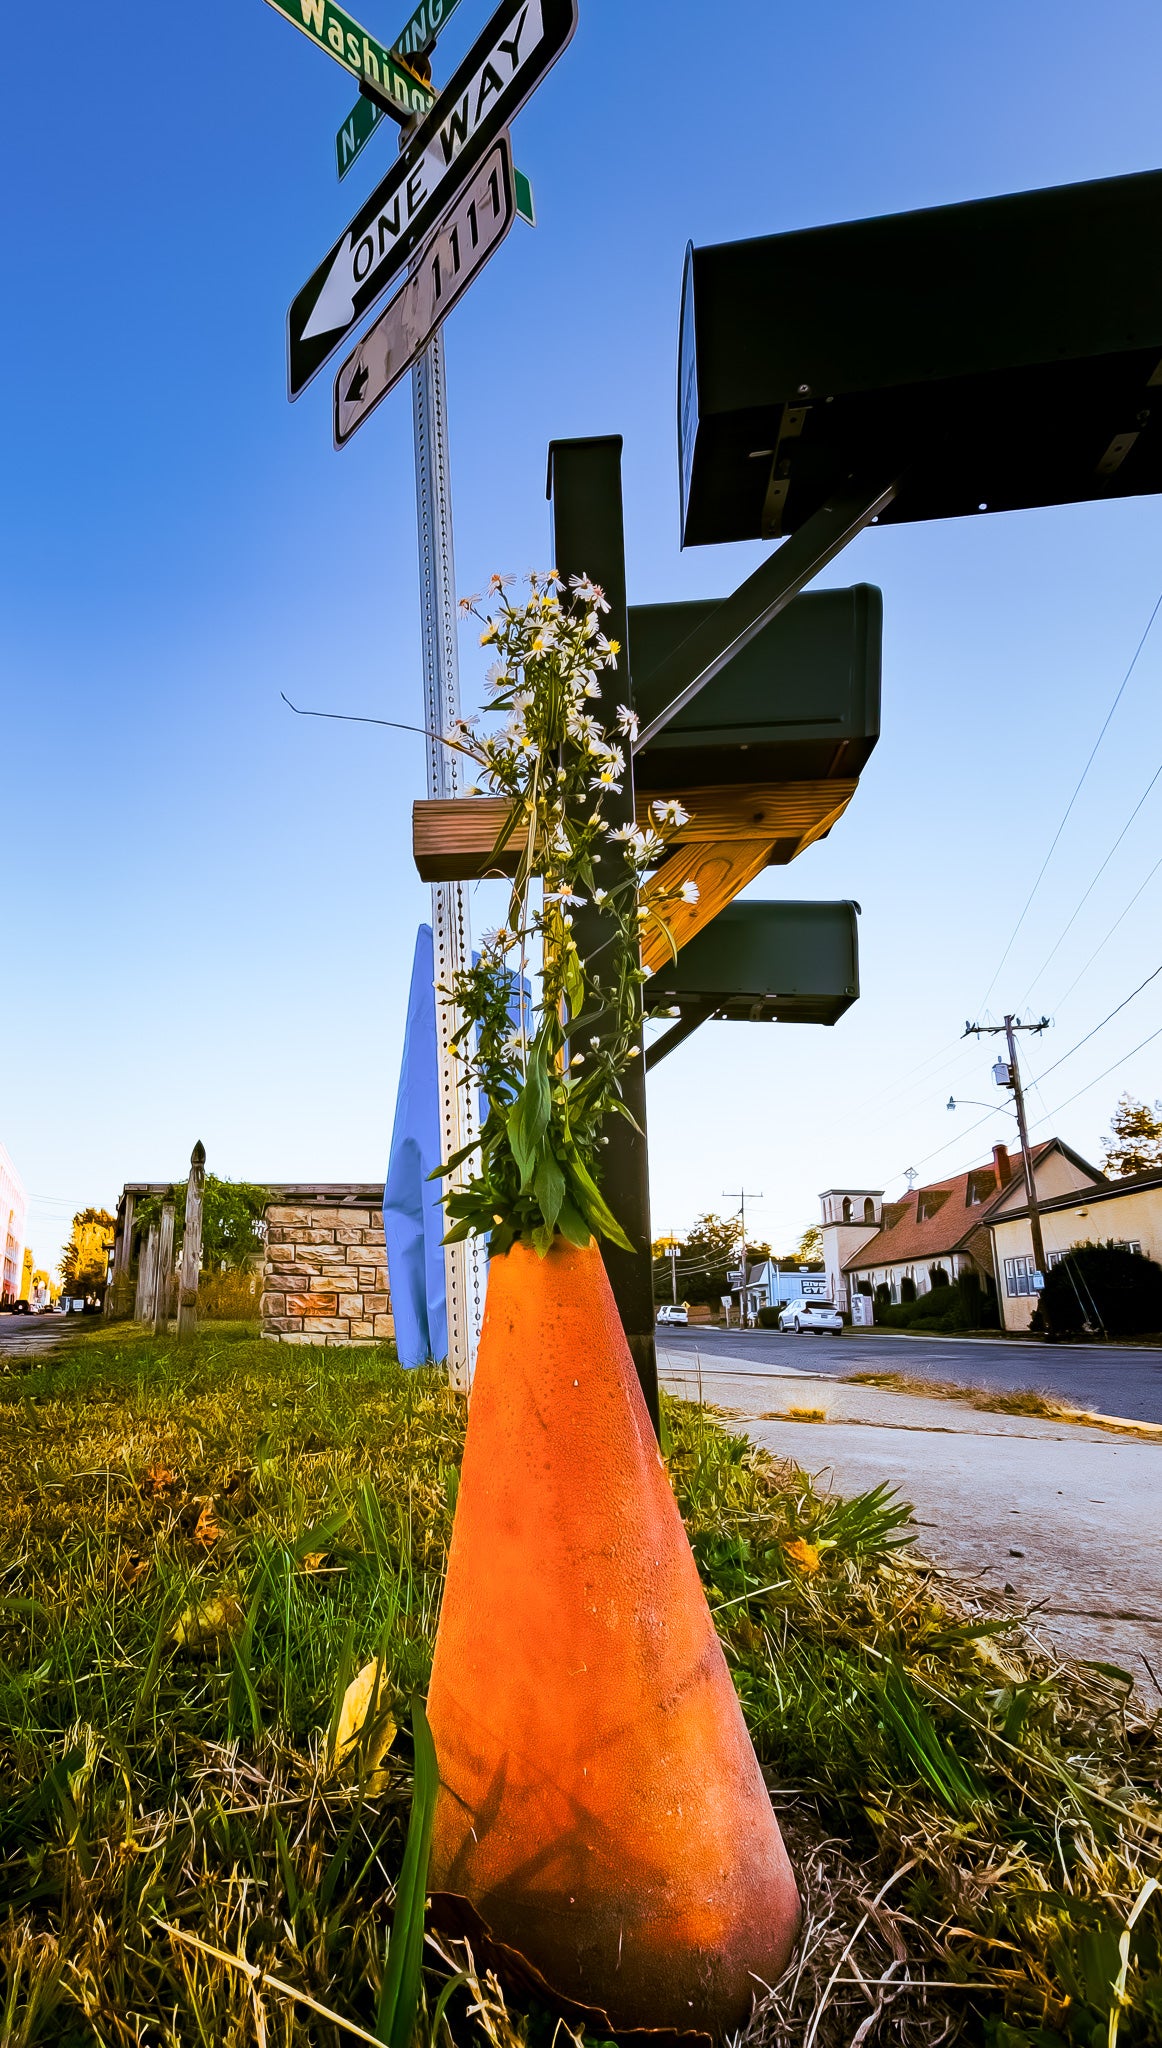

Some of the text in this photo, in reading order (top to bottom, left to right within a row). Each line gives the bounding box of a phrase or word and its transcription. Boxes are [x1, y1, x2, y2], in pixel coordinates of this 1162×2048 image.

[341, 117, 360, 167] N.
[353, 7, 528, 282] ONE WAY
